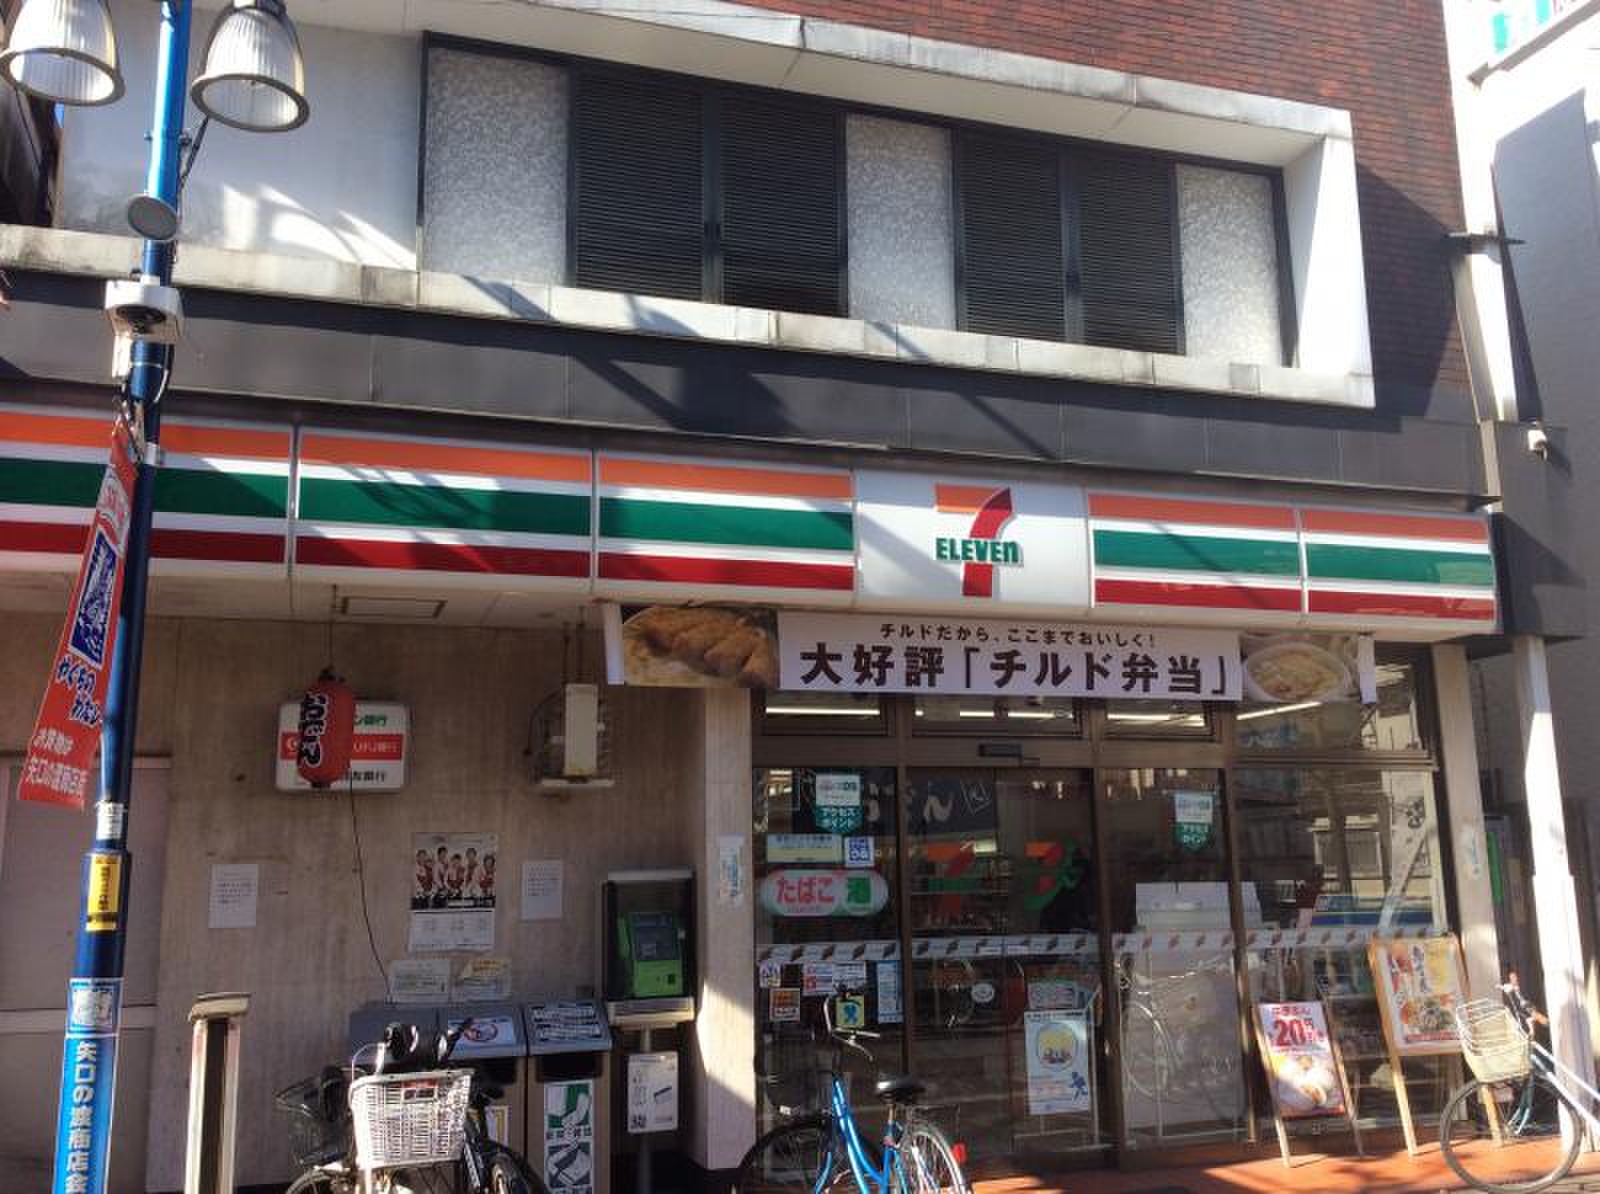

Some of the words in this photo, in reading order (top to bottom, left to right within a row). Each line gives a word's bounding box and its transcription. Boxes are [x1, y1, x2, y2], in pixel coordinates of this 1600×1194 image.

[800, 641, 1228, 695] 大好評「チルド弁当」
[353, 714, 388, 726] ン銀行
[775, 876, 834, 904] たばこ
